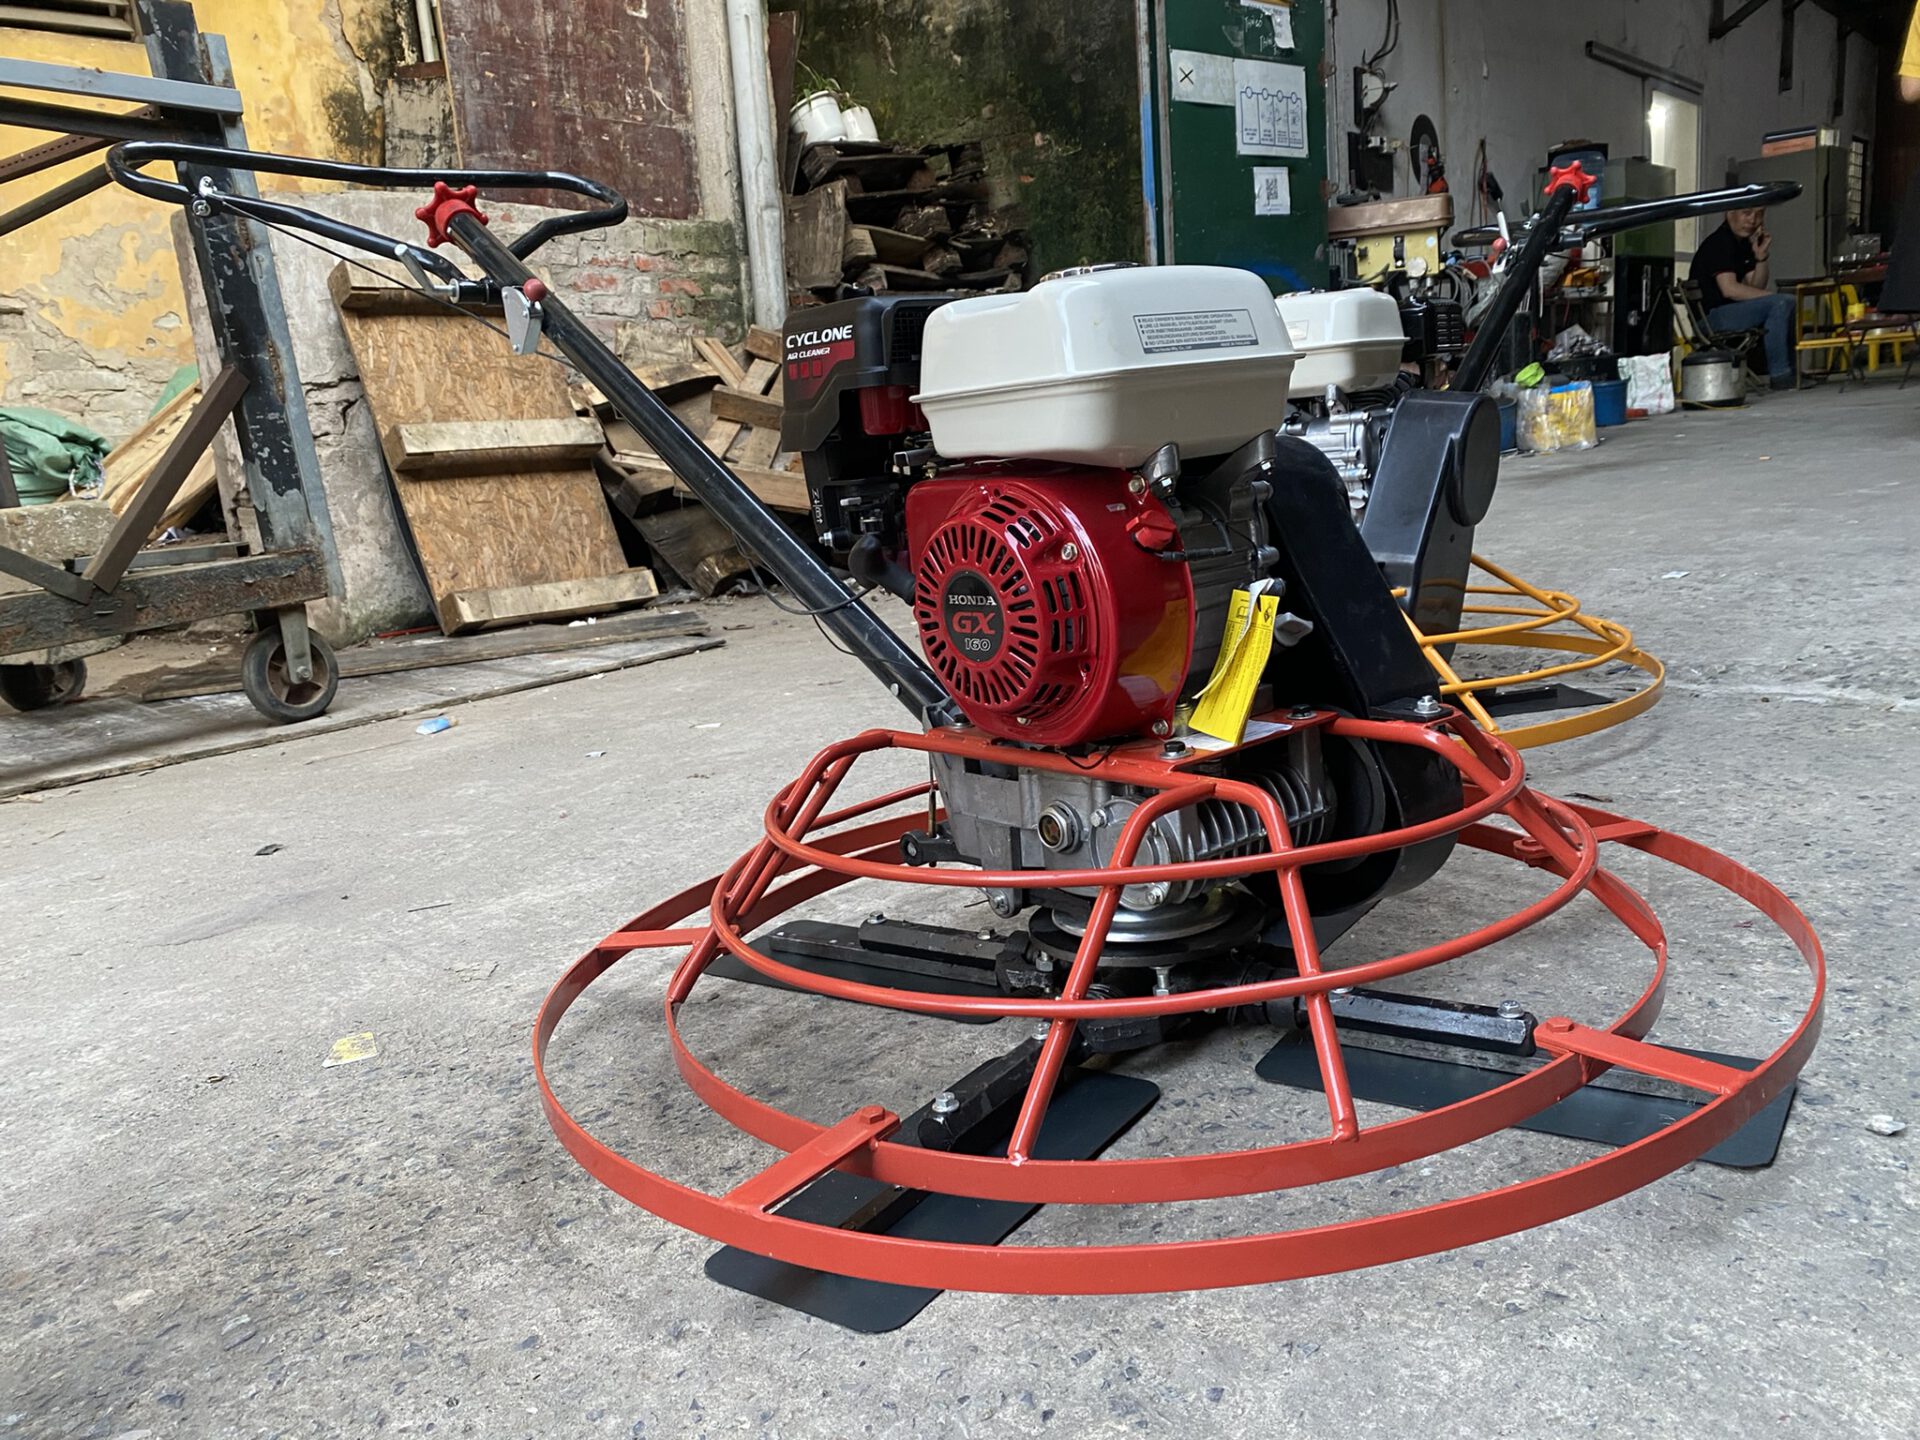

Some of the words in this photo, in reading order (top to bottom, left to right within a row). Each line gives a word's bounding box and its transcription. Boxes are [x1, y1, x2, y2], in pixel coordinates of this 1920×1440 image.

[786, 324, 853, 349] CYCLONE
[787, 351, 799, 361] AIR
[799, 347, 830, 358] CLEANER
[948, 594, 997, 606] HONDA
[952, 611, 996, 635] GX
[965, 637, 991, 652] 160
